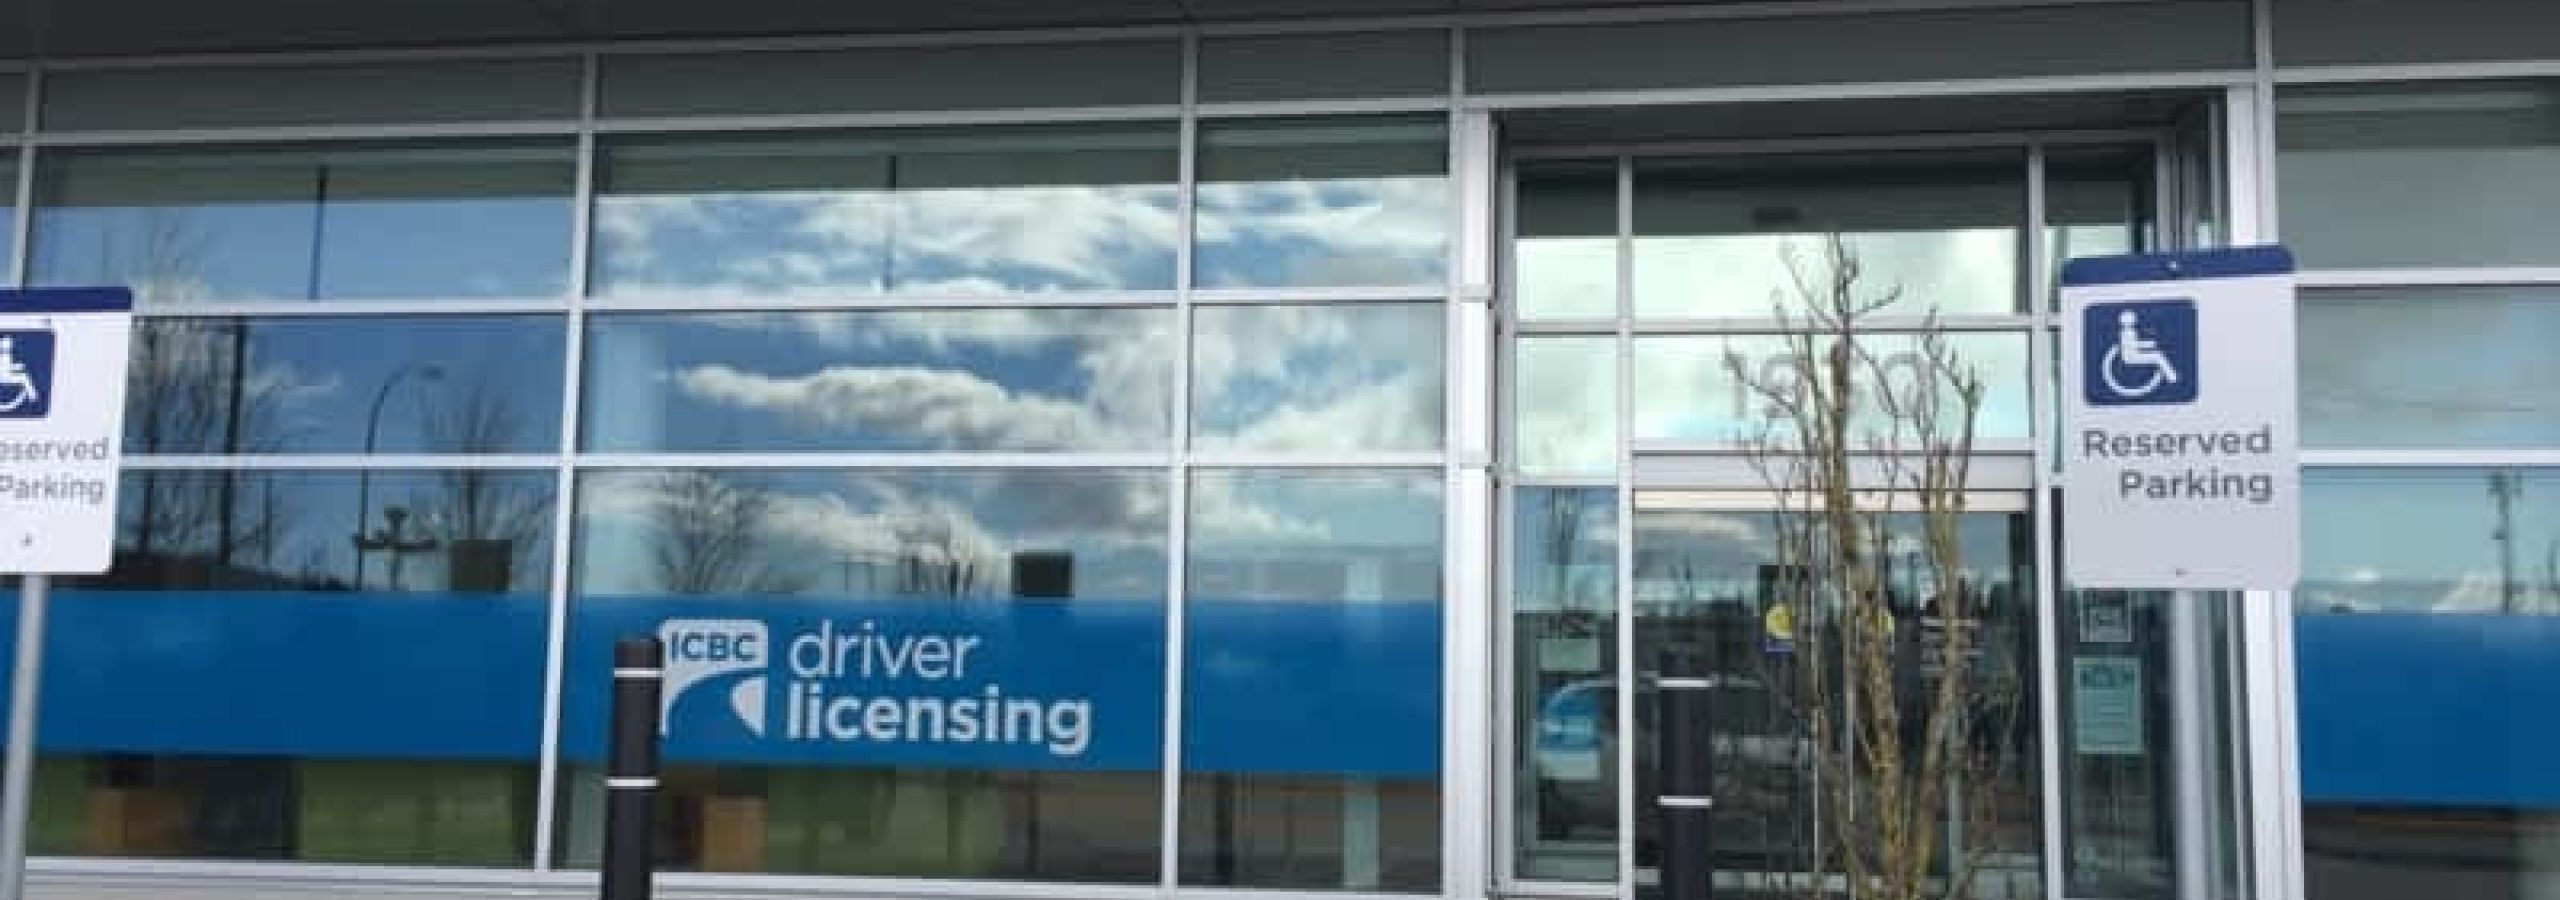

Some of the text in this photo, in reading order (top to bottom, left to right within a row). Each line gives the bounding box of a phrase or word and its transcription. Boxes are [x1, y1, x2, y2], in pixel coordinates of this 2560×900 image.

[2082, 423, 2273, 457] Reserved
[2119, 466, 2273, 503] Parking
[669, 631, 757, 662] ICBC
[788, 619, 982, 680] driver
[785, 682, 1092, 755] licensing
